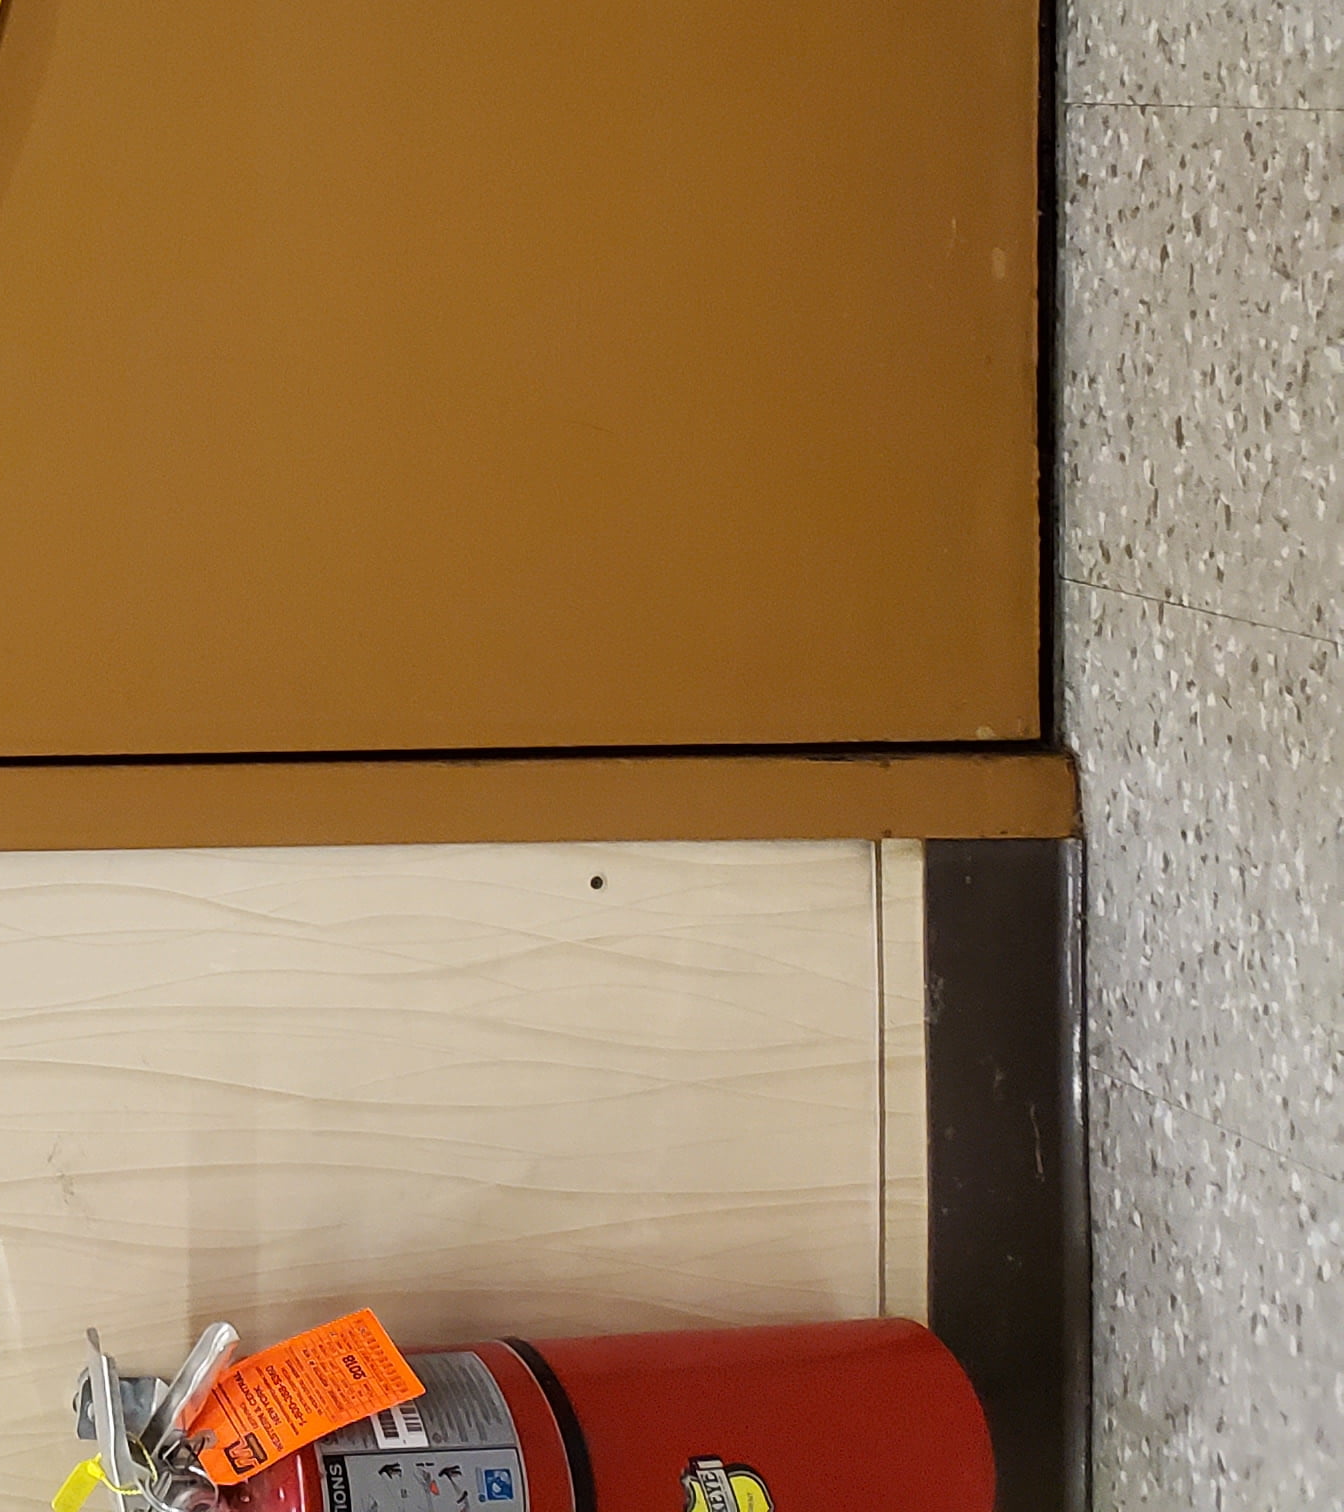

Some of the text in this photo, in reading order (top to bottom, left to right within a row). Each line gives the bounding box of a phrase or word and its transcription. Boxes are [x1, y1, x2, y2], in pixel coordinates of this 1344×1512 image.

[341, 1352, 367, 1383] 2018
[231, 1371, 259, 1407] CENTRAL
[252, 1384, 282, 1426] NEW YORK
